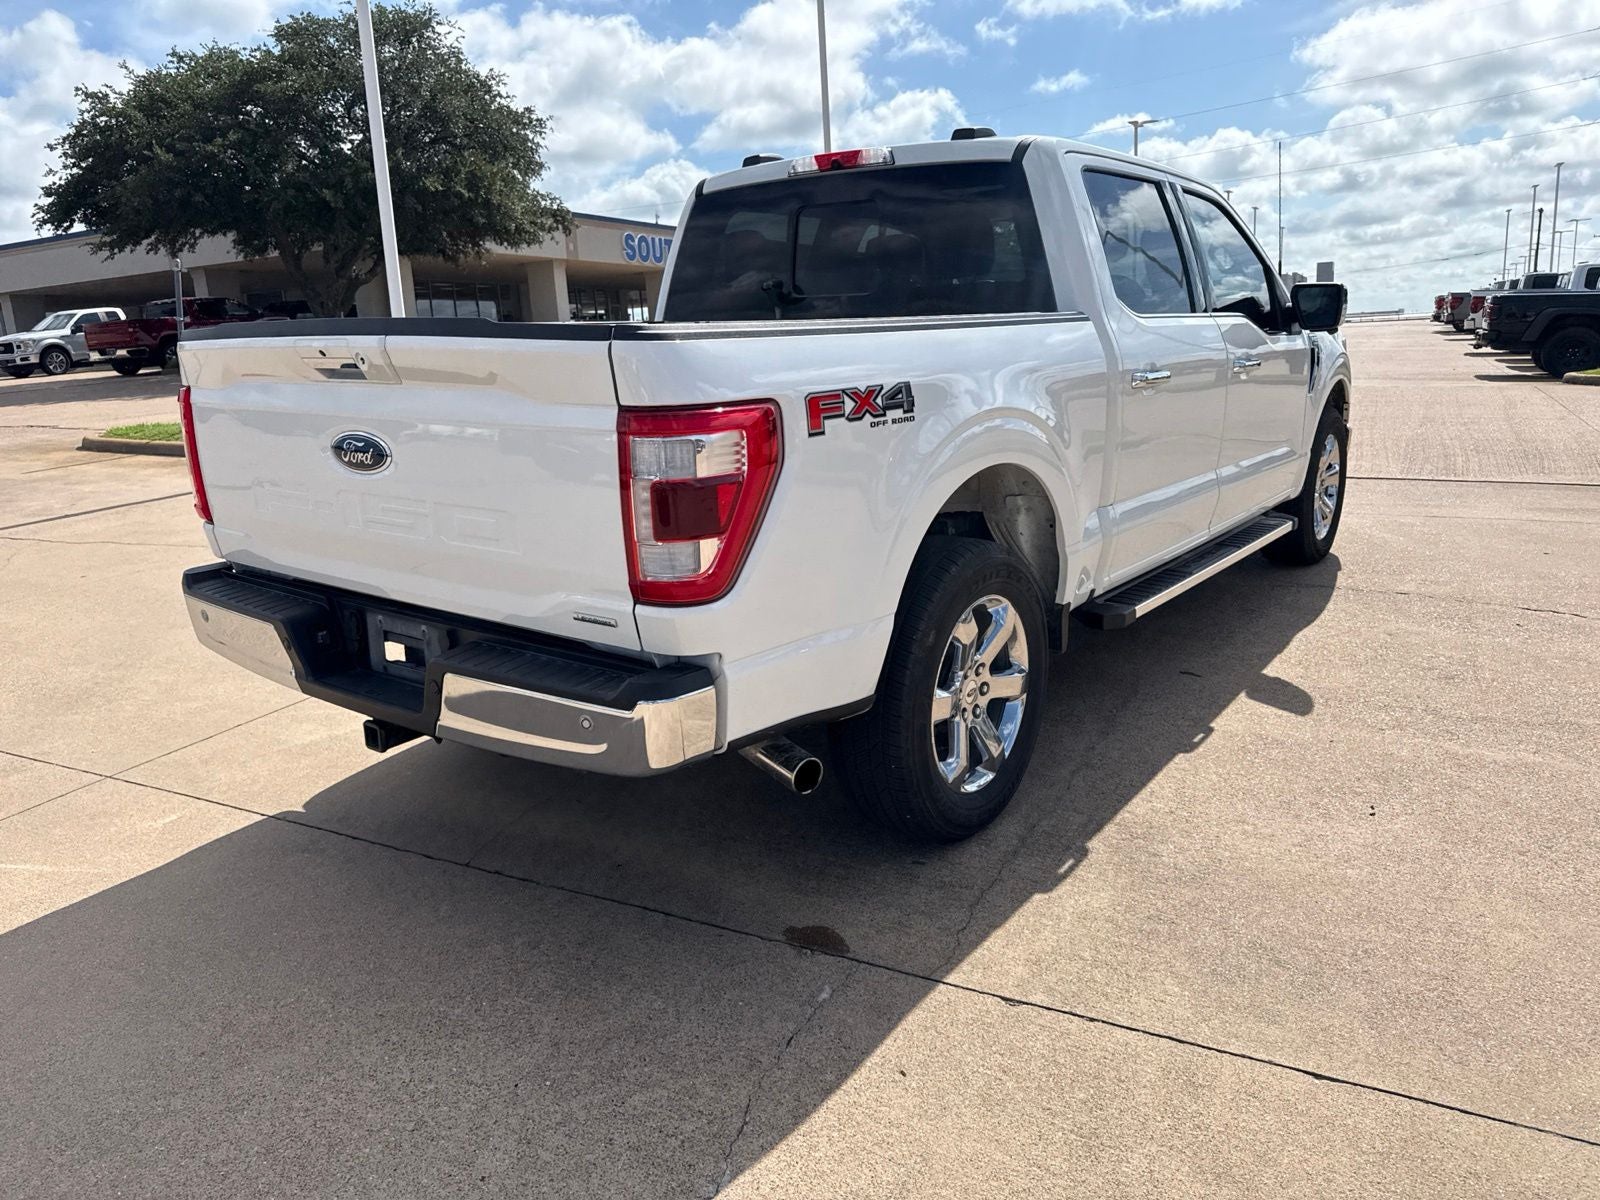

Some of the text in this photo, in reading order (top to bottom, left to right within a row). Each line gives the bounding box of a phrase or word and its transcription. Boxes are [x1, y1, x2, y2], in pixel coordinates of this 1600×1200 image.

[804, 381, 915, 438] FX4
[869, 415, 916, 428] OFF ROAD
[341, 439, 374, 465] Ford
